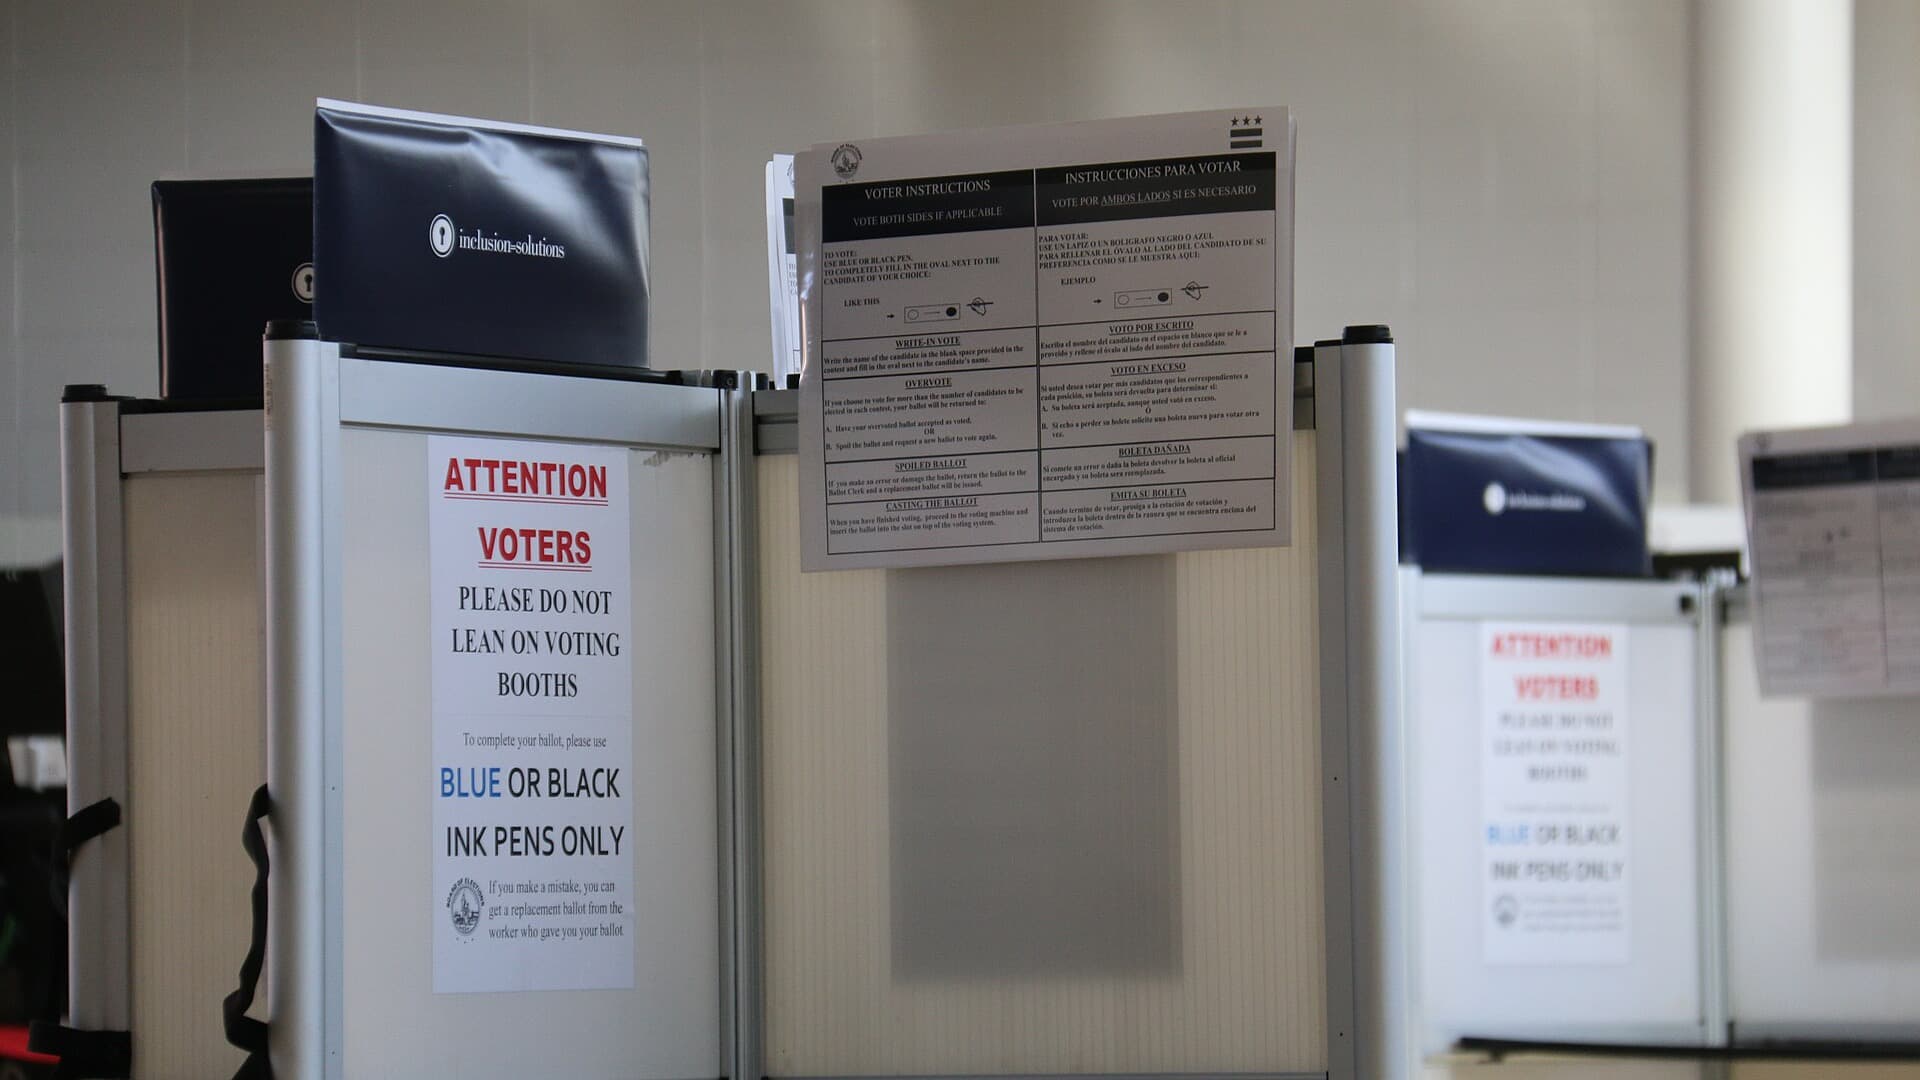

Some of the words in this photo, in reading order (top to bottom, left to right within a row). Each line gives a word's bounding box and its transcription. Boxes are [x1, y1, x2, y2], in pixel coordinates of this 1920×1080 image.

[1064, 165, 1161, 186] INSTRUCCIONES
[1163, 162, 1196, 178] PARA
[1198, 159, 1240, 176] VOTAR
[864, 185, 903, 201] VOTER
[905, 179, 991, 198] INSTRUCTIONS
[444, 457, 607, 498] ATTENTION
[478, 527, 592, 564] VOTERS
[459, 586, 534, 612] PLEASE
[540, 589, 566, 614] DO
[572, 590, 612, 615] NOT
[451, 628, 505, 653] LEAN
[511, 630, 539, 655] ON
[544, 631, 620, 657] VOTING
[498, 672, 578, 698] BOOTHS
[463, 733, 475, 747] To
[477, 733, 515, 750] complete
[517, 737, 537, 750] your
[539, 733, 564, 748] ballot,
[566, 734, 591, 750] please
[594, 737, 607, 748] use
[440, 767, 501, 798] BLUE
[508, 767, 541, 798] OR
[548, 768, 621, 798] BLACK
[447, 826, 487, 857] INK
[494, 826, 554, 857] PENS
[561, 826, 625, 856] ONLY
[489, 880, 497, 894] If
[498, 883, 514, 897] you
[516, 880, 538, 894] make
[540, 883, 546, 893] a
[547, 879, 582, 895] mistake,
[584, 882, 599, 896] you
[600, 882, 615, 892] can
[488, 905, 502, 920] get
[503, 906, 509, 916] a
[511, 902, 561, 919] replacement
[563, 901, 586, 916] ballot
[588, 901, 608, 915] from
[609, 901, 623, 914] the
[489, 925, 518, 939] worker
[520, 925, 539, 938] who
[540, 927, 560, 941] gave
[562, 927, 577, 941] you
[579, 926, 598, 941] your
[599, 923, 623, 937] ballot
